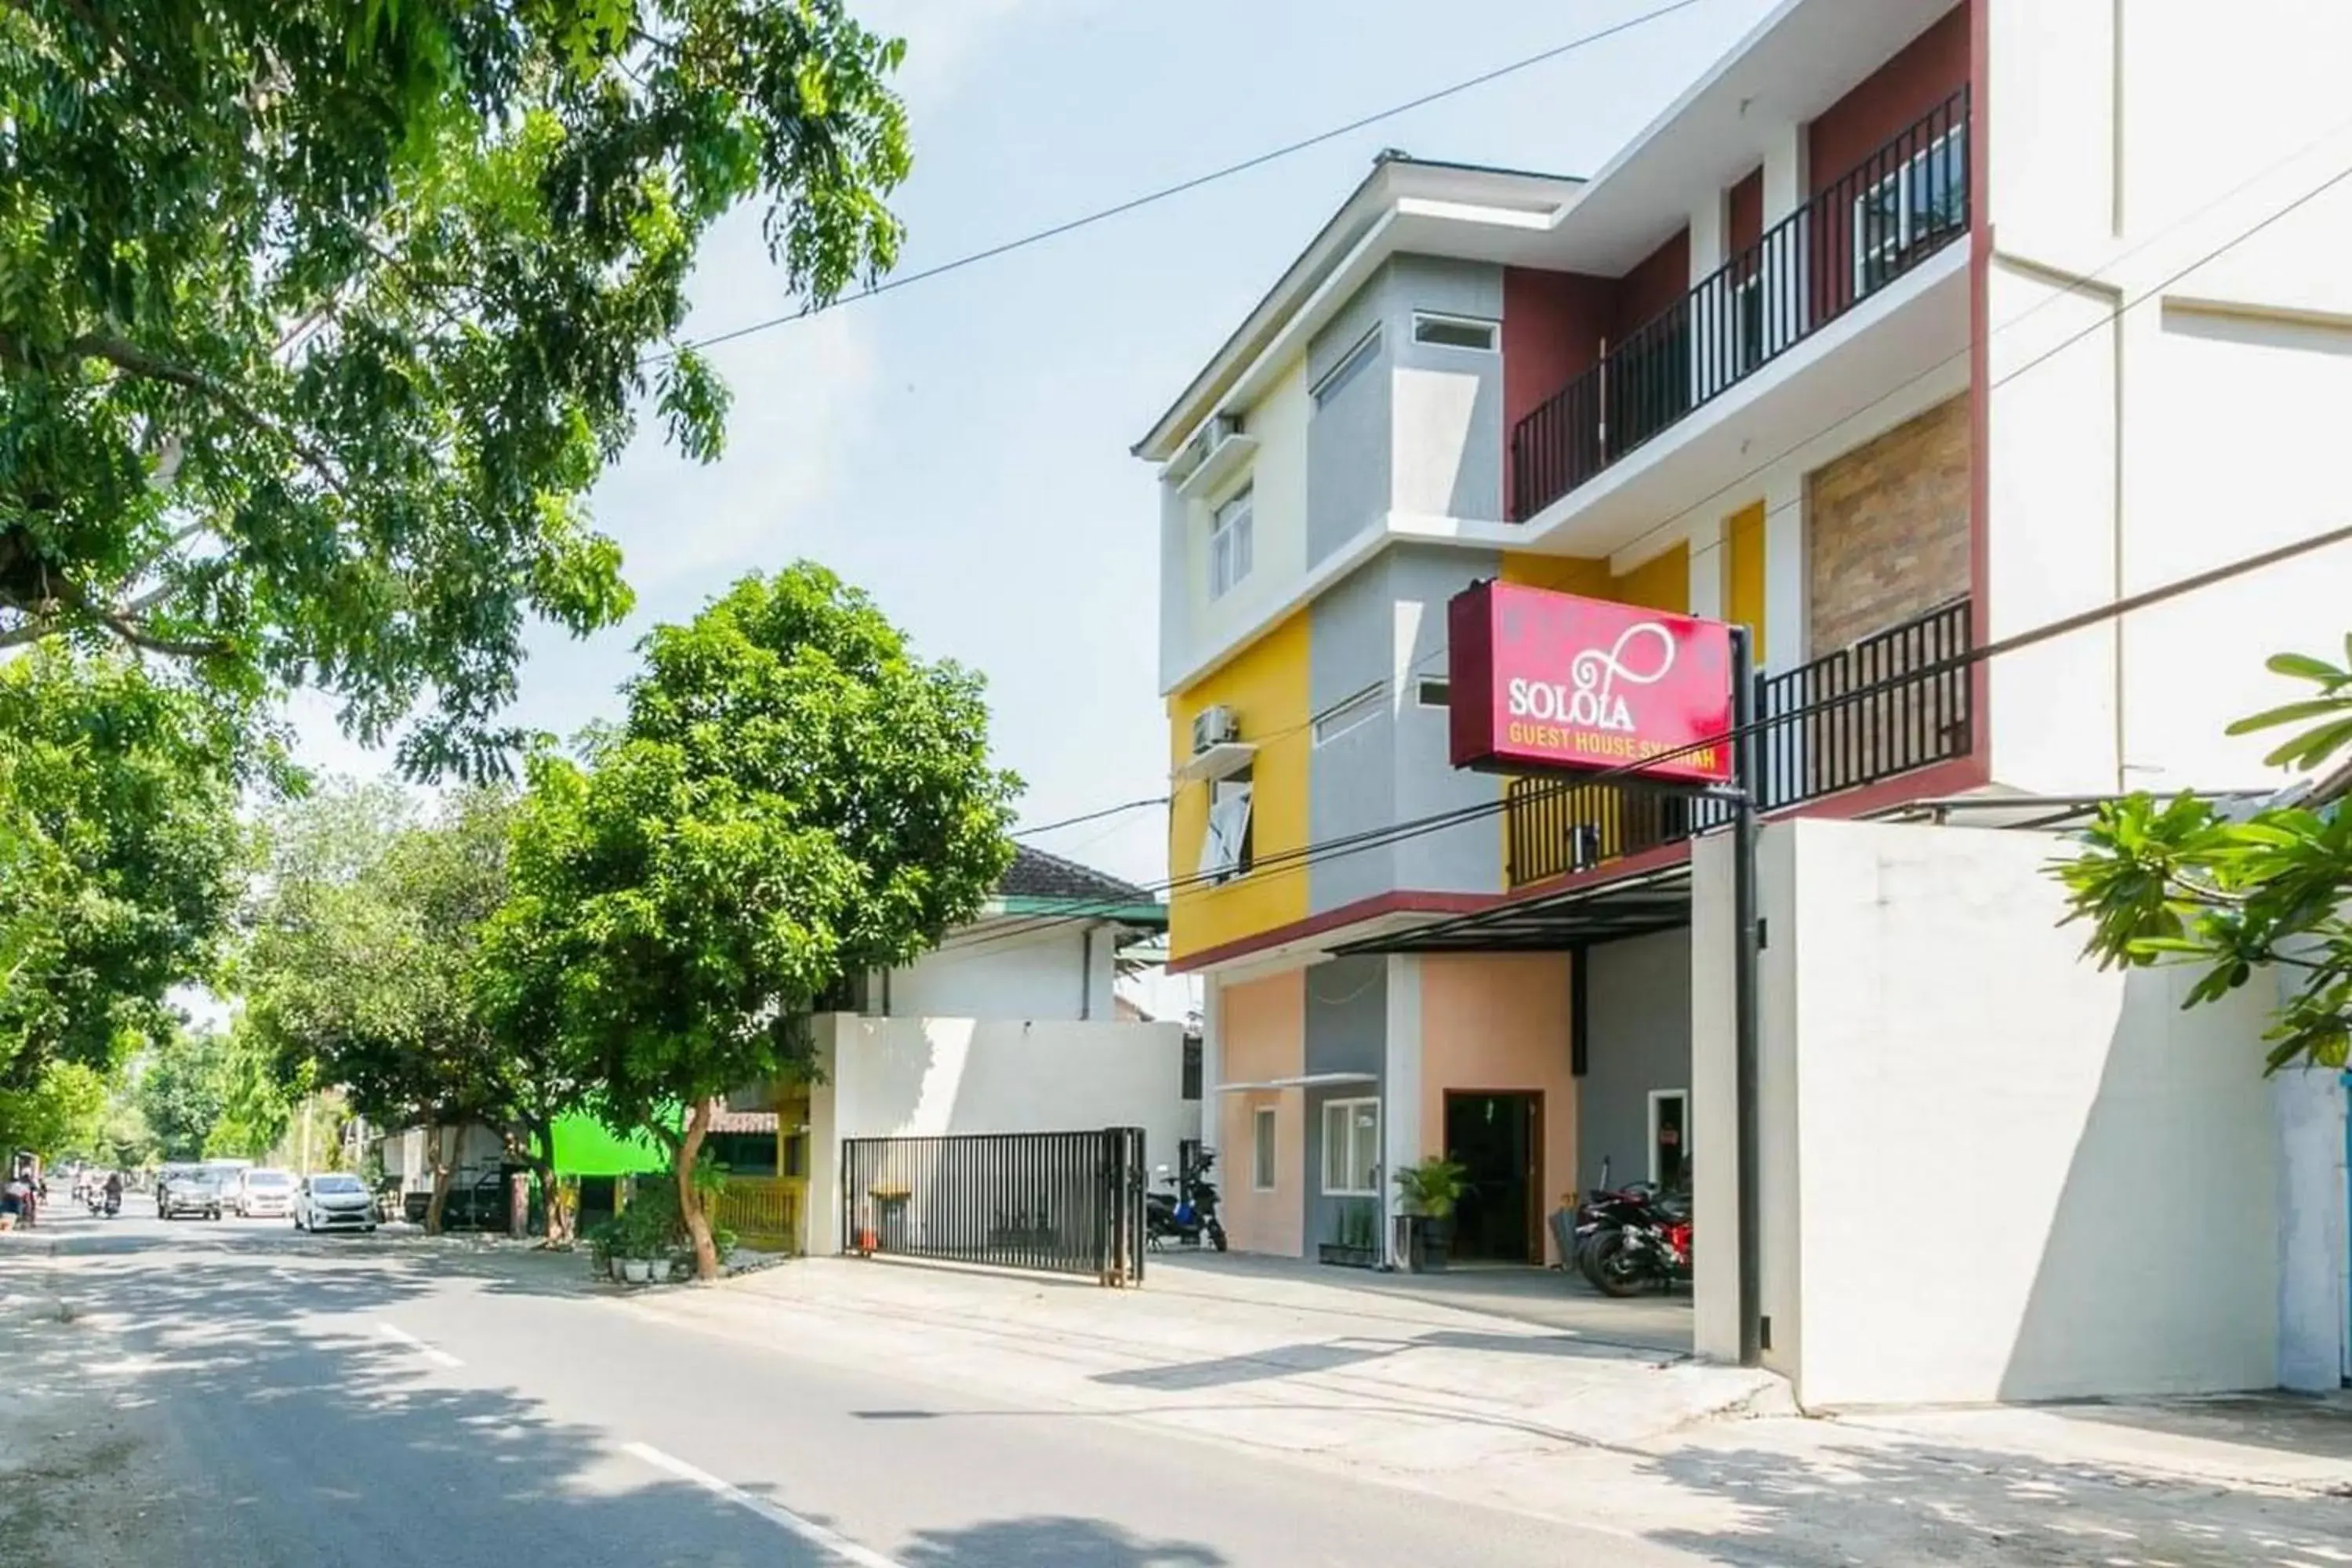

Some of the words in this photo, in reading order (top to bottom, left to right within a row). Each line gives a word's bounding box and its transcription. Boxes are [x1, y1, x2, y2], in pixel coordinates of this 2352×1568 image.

[1508, 677, 1636, 731] SOLOLA
[1508, 721, 1570, 748] GUEST
[1575, 731, 1636, 756] HOUSE
